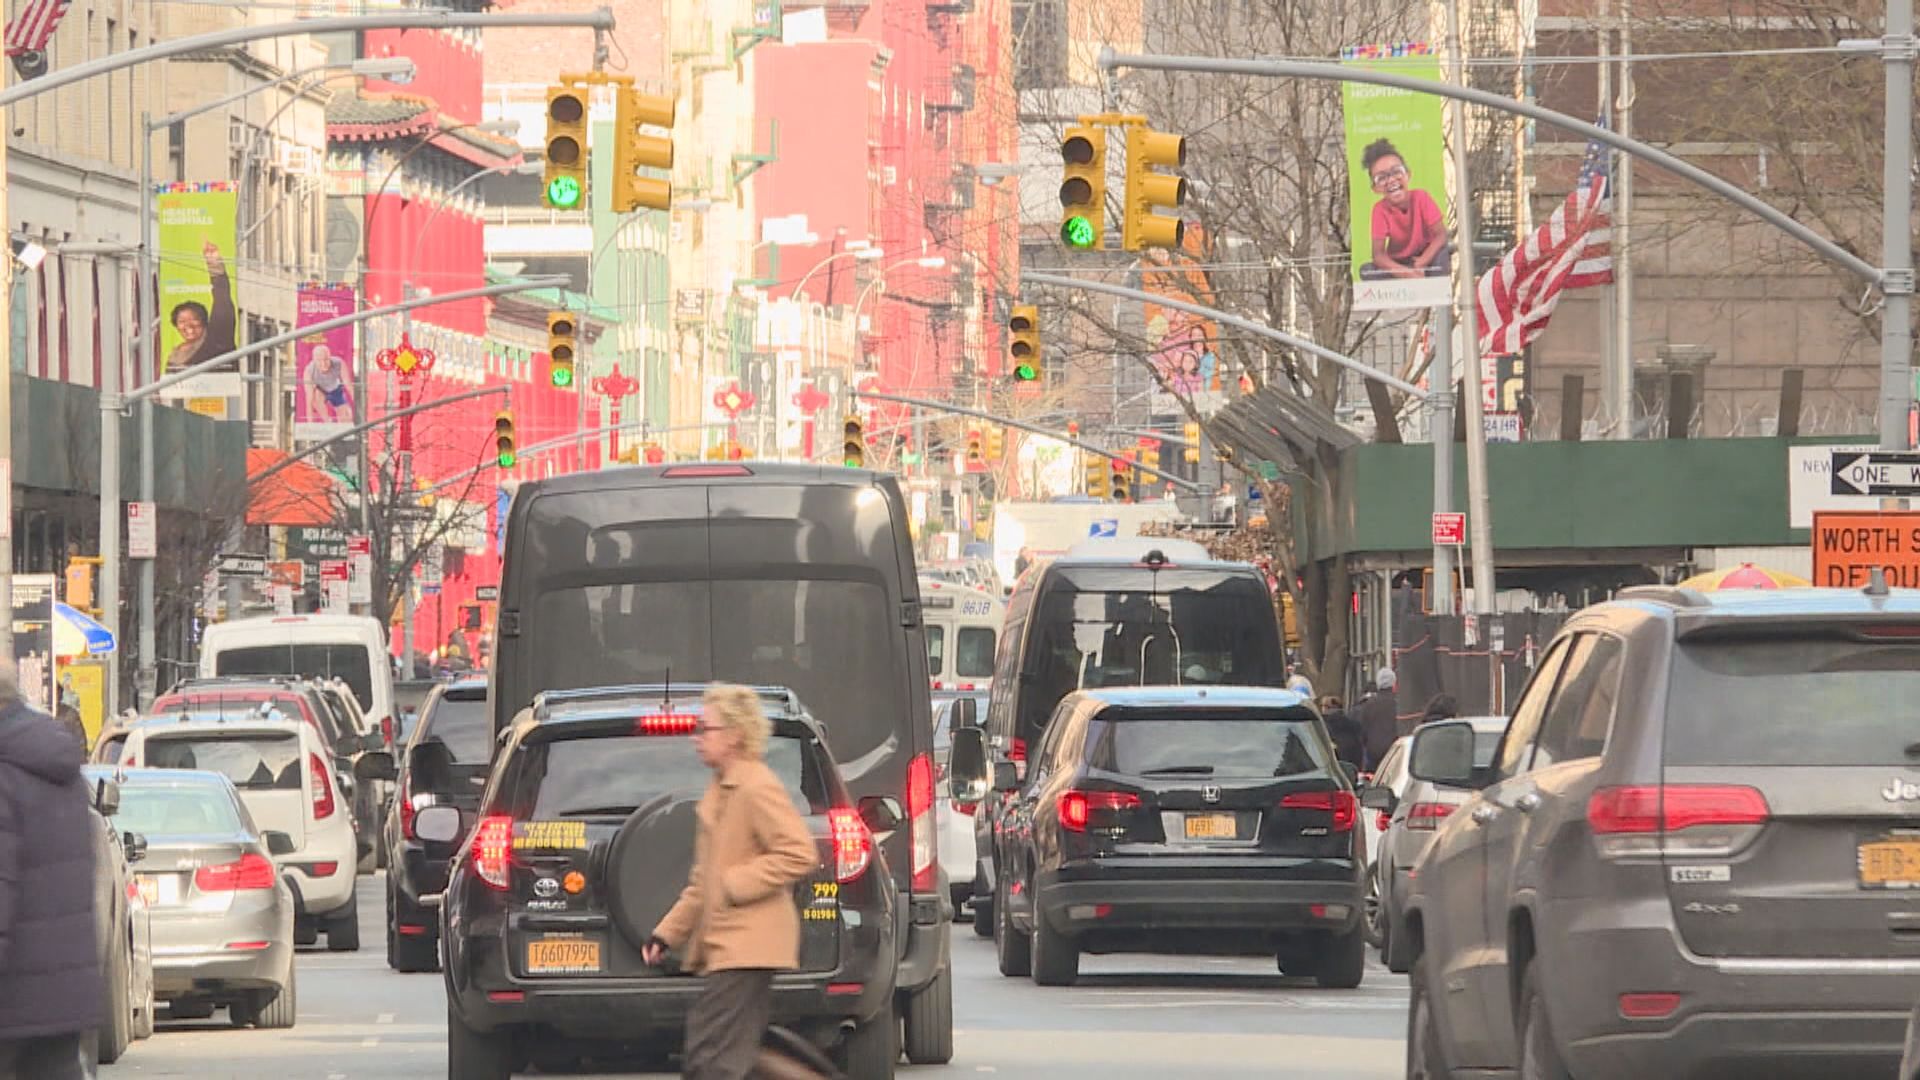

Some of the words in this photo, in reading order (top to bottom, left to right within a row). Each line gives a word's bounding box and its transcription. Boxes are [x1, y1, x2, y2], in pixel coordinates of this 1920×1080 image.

[1852, 466, 1890, 483] ONE
[1823, 528, 1899, 553] WORTH
[1882, 778, 1920, 800] Je
[814, 882, 837, 897] 799
[533, 944, 596, 963] T660799C
